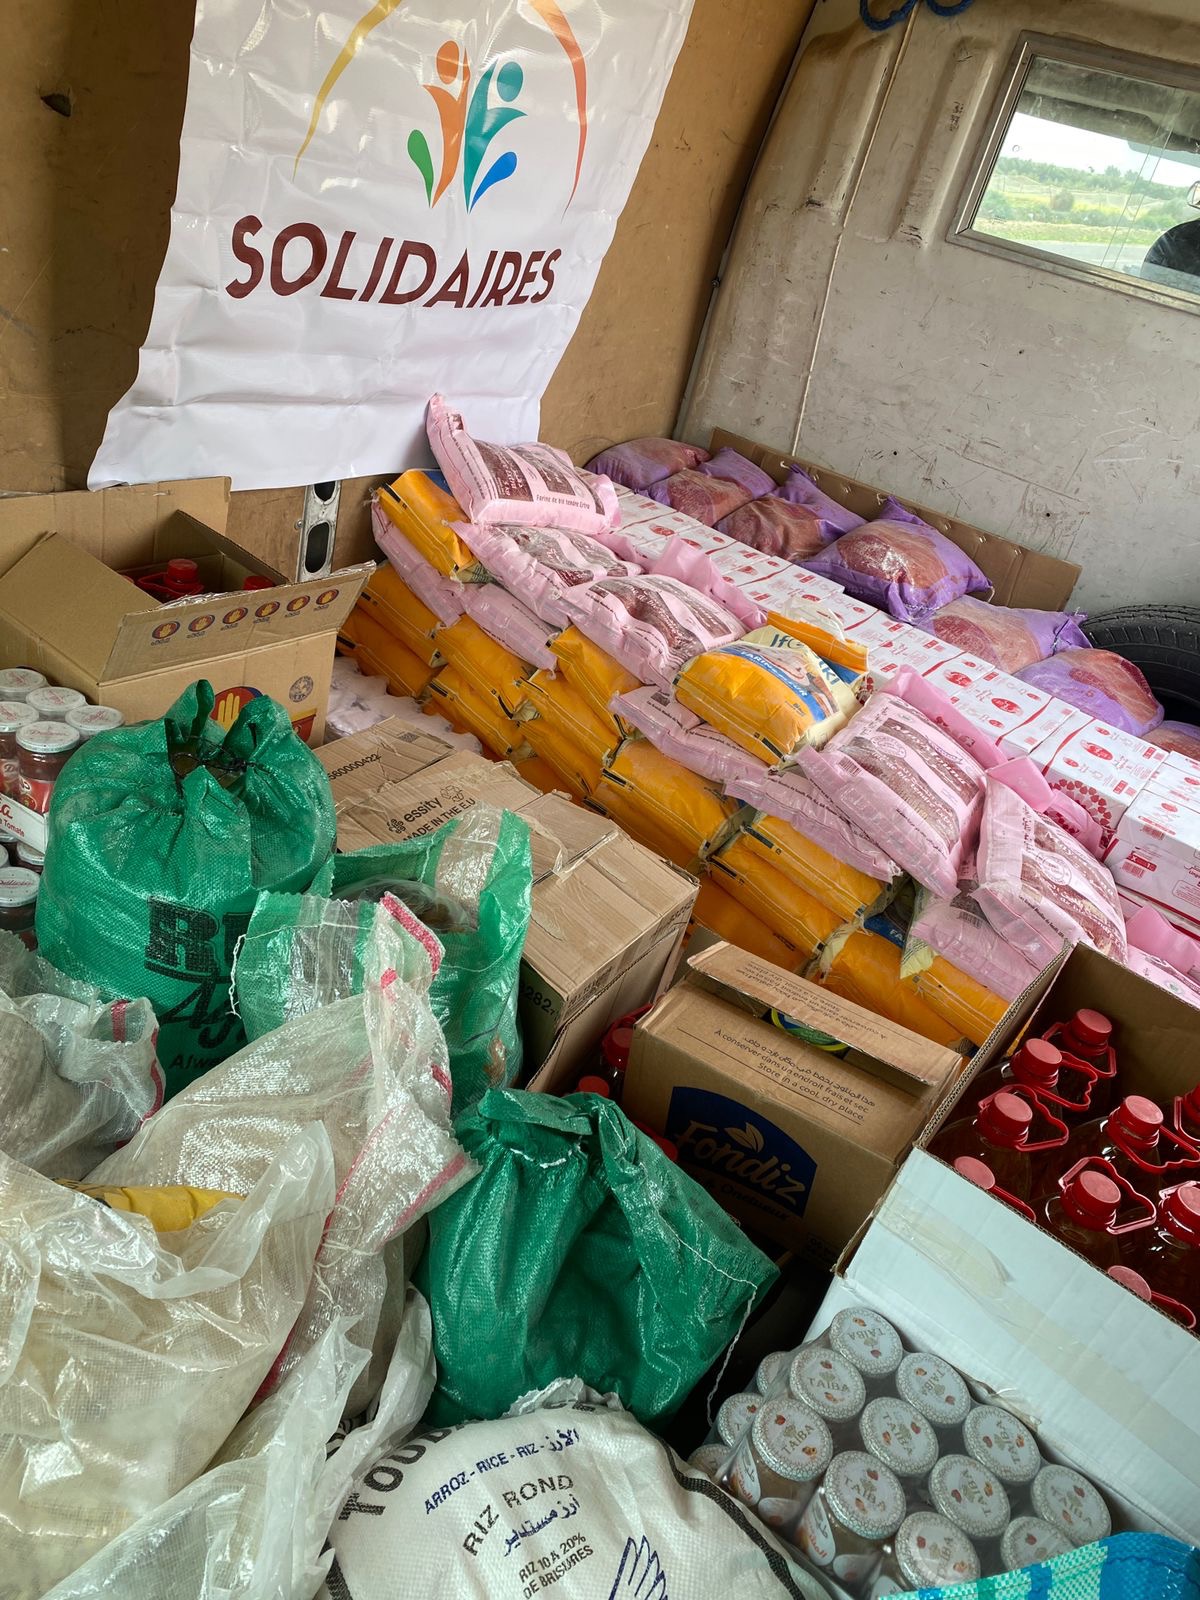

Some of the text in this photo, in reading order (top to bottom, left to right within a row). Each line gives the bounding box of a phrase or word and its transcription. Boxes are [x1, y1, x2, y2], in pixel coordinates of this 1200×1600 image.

[225, 214, 562, 309] SOLIDAIRES
[402, 794, 443, 828] essity
[431, 815, 444, 828] IN
[440, 804, 462, 822] THE
[722, 1033, 762, 1058] conserver
[761, 1053, 782, 1069] dans
[781, 1064, 793, 1075] un
[793, 1070, 825, 1091] endroit
[824, 1086, 844, 1101] frais
[842, 1096, 854, 1106] et
[853, 1102, 870, 1114] sec
[757, 1061, 782, 1079] Store
[821, 1094, 839, 1110] dry
[673, 1119, 806, 1207] Fondiz
[848, 1328, 885, 1340] TAIBA
[808, 1377, 849, 1391] TAIBA
[781, 1424, 814, 1454] TAIBA
[424, 1470, 470, 1515] ARROZ
[475, 1452, 510, 1474] RICE
[516, 1443, 540, 1458] RIZ
[462, 1474, 575, 1557] RIZ ROND
[518, 1561, 538, 1584] RIZ
[537, 1556, 550, 1570] 10
[560, 1531, 587, 1556] 20%
[540, 1545, 594, 1589] BRISURES
